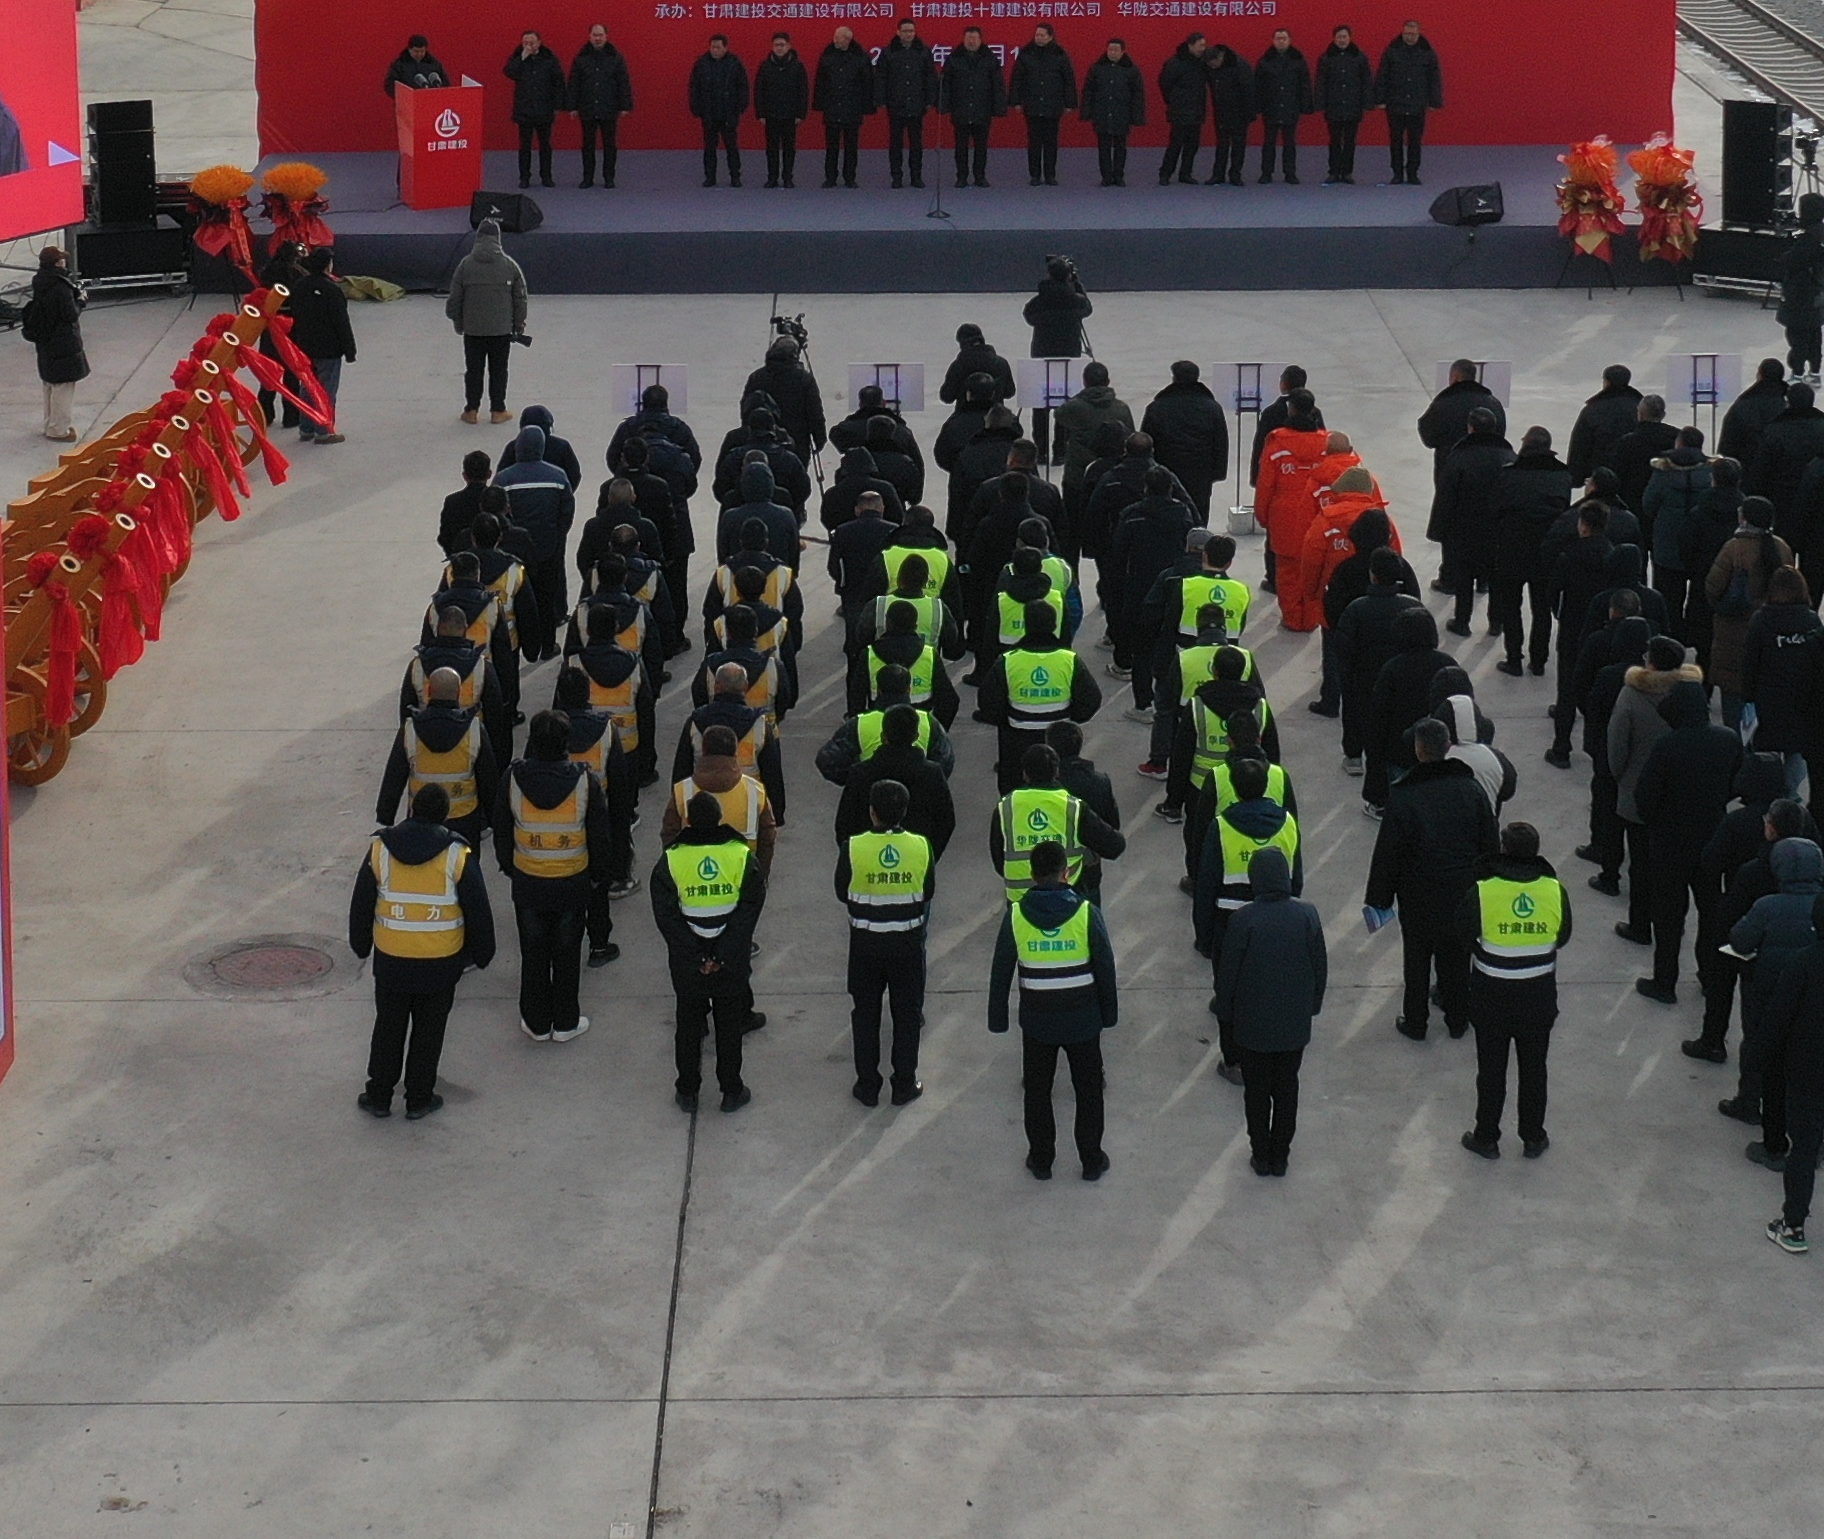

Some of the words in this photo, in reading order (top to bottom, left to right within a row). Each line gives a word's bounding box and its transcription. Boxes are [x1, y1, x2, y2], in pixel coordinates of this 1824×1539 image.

[866, 871, 914, 885] 甘肃建投
[684, 882, 734, 898] 甘肃建投
[1497, 921, 1548, 935] 甘肃建投
